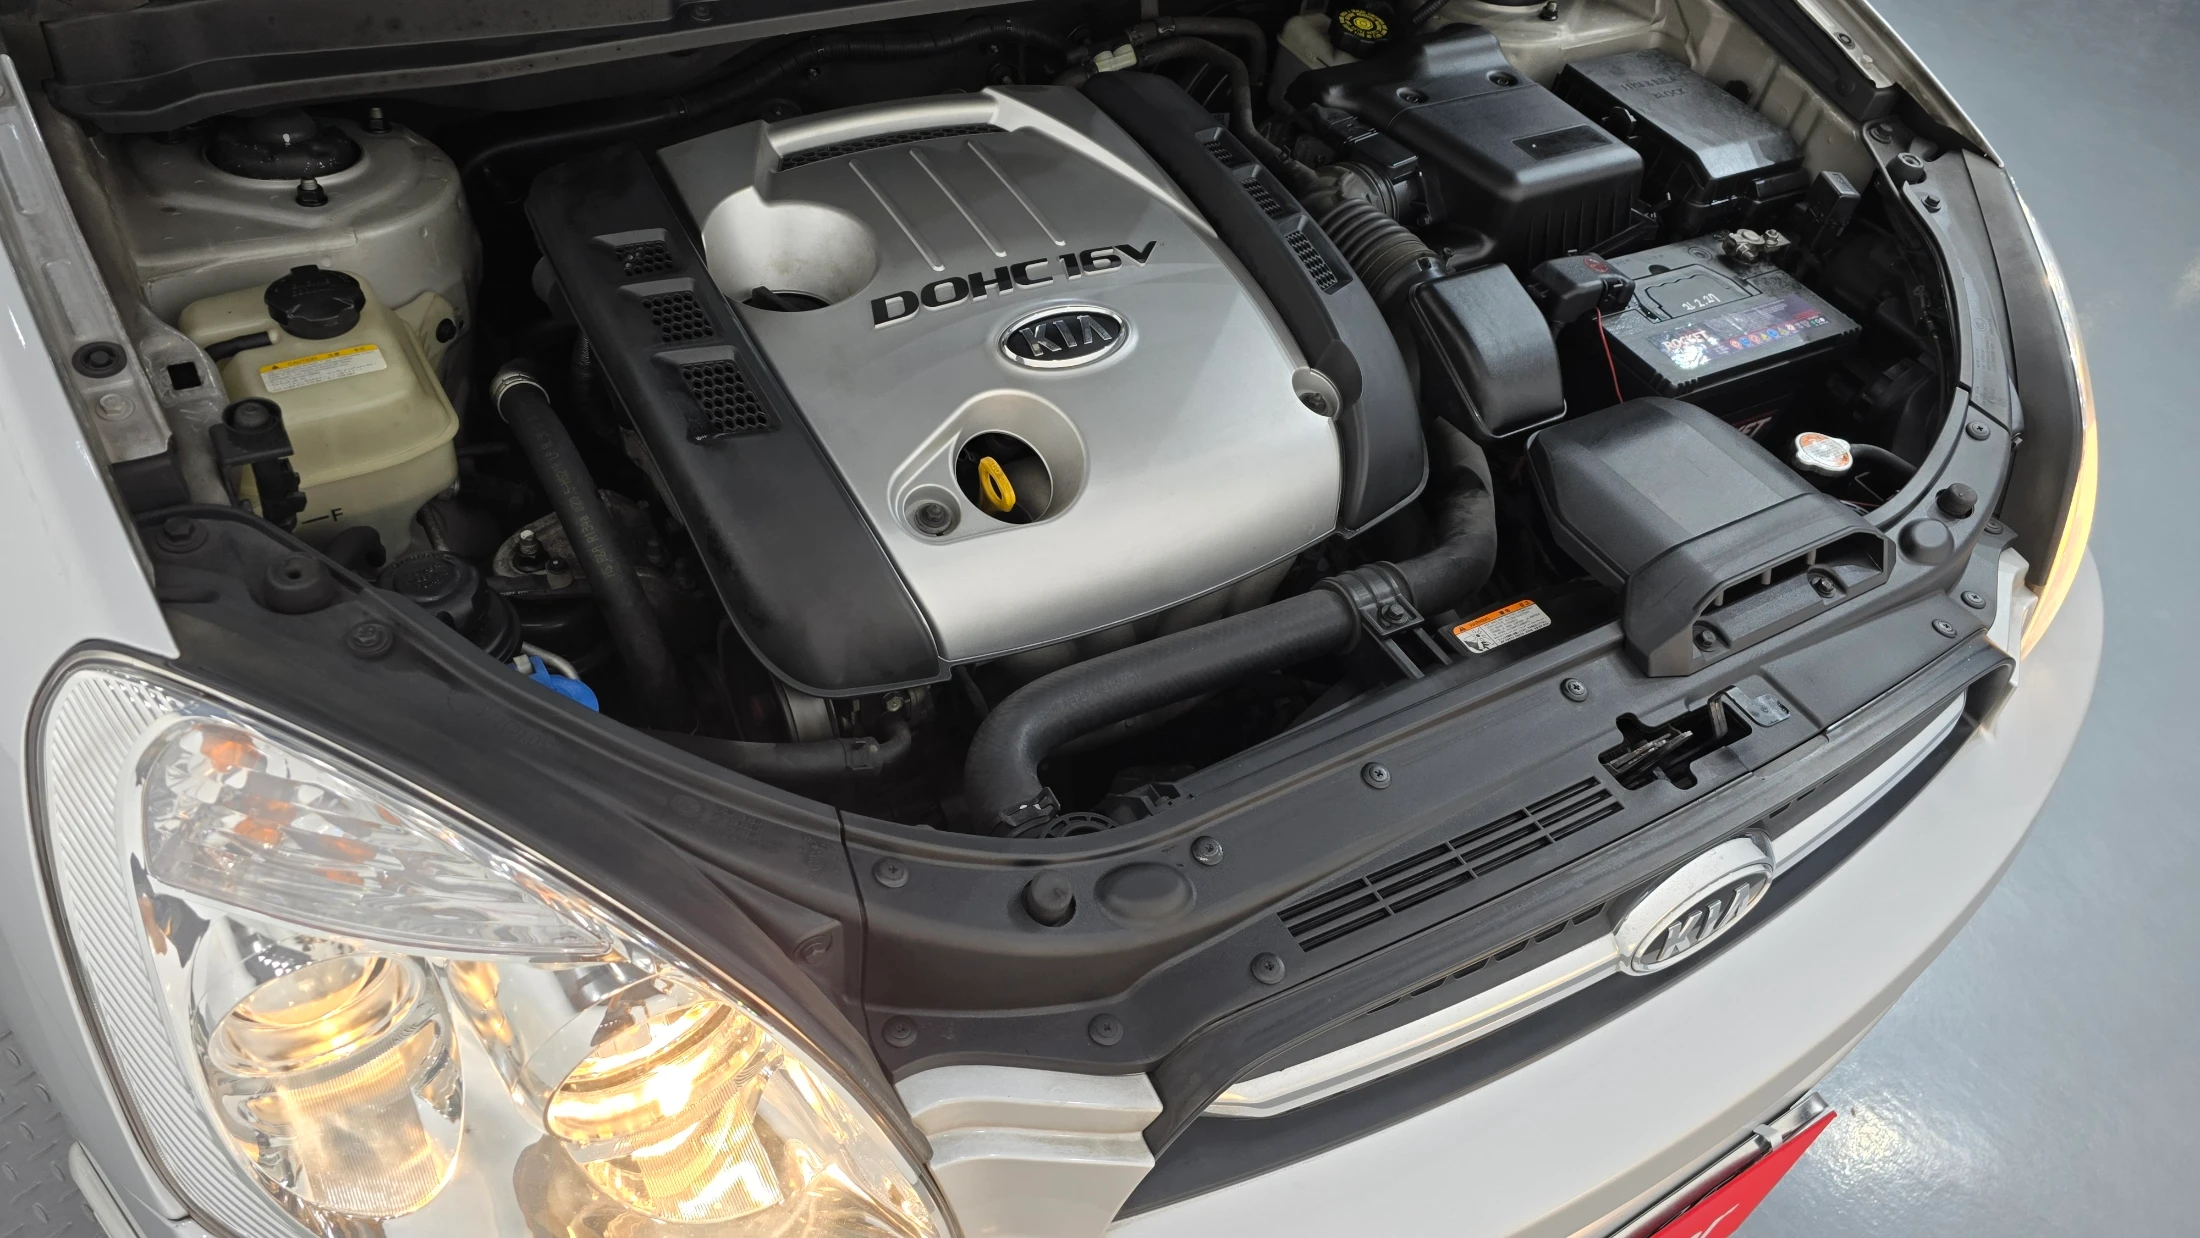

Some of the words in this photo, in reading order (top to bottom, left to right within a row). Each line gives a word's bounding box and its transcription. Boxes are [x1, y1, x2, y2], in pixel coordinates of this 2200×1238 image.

[870, 257, 1053, 329] DOHC
[1059, 240, 1157, 281] 16V
[1019, 314, 1112, 357] KIA
[331, 506, 344, 522] F
[1657, 882, 1750, 962] KIA
